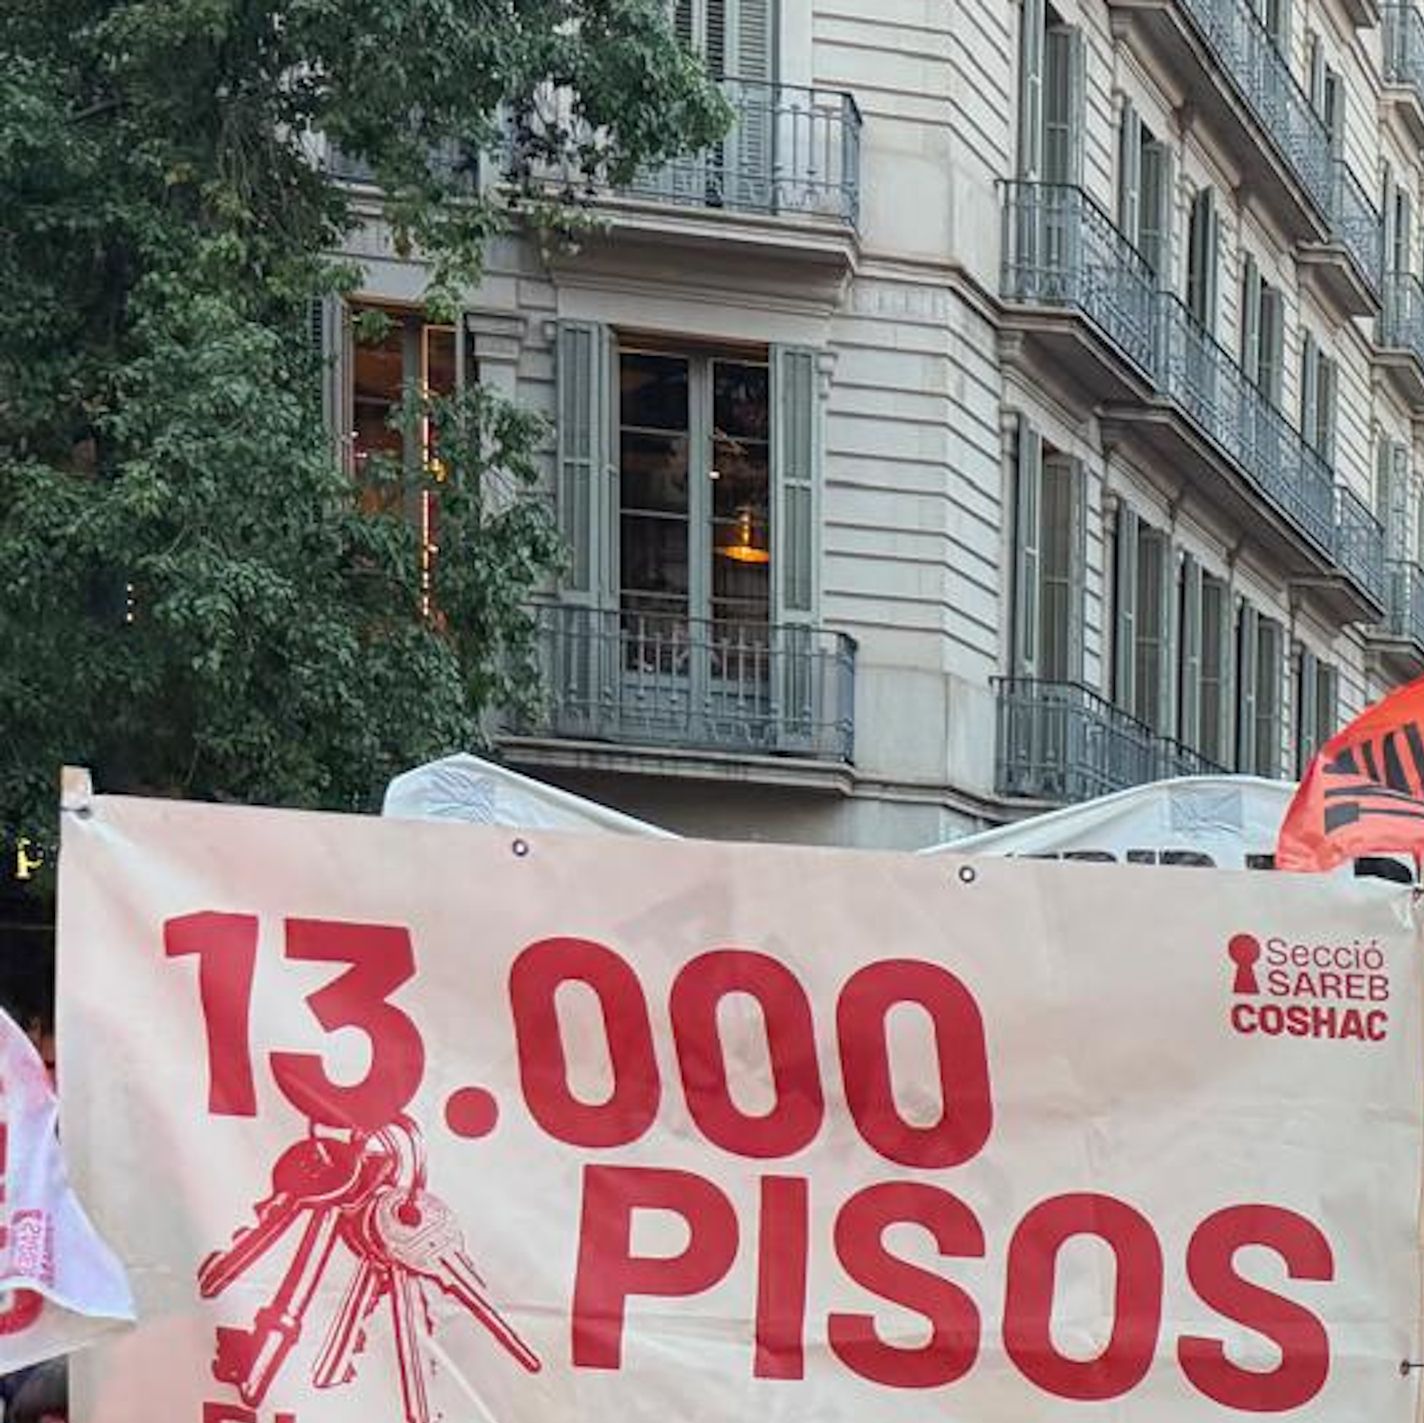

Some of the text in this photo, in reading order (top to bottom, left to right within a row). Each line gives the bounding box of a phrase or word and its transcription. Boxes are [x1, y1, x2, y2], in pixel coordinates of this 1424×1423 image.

[1266, 938, 1386, 970] Secció
[1267, 971, 1390, 1001] SAREB
[162, 911, 993, 1169] 13.000
[1231, 1003, 1388, 1042] COSHAC
[571, 1162, 1335, 1413] PISOS
